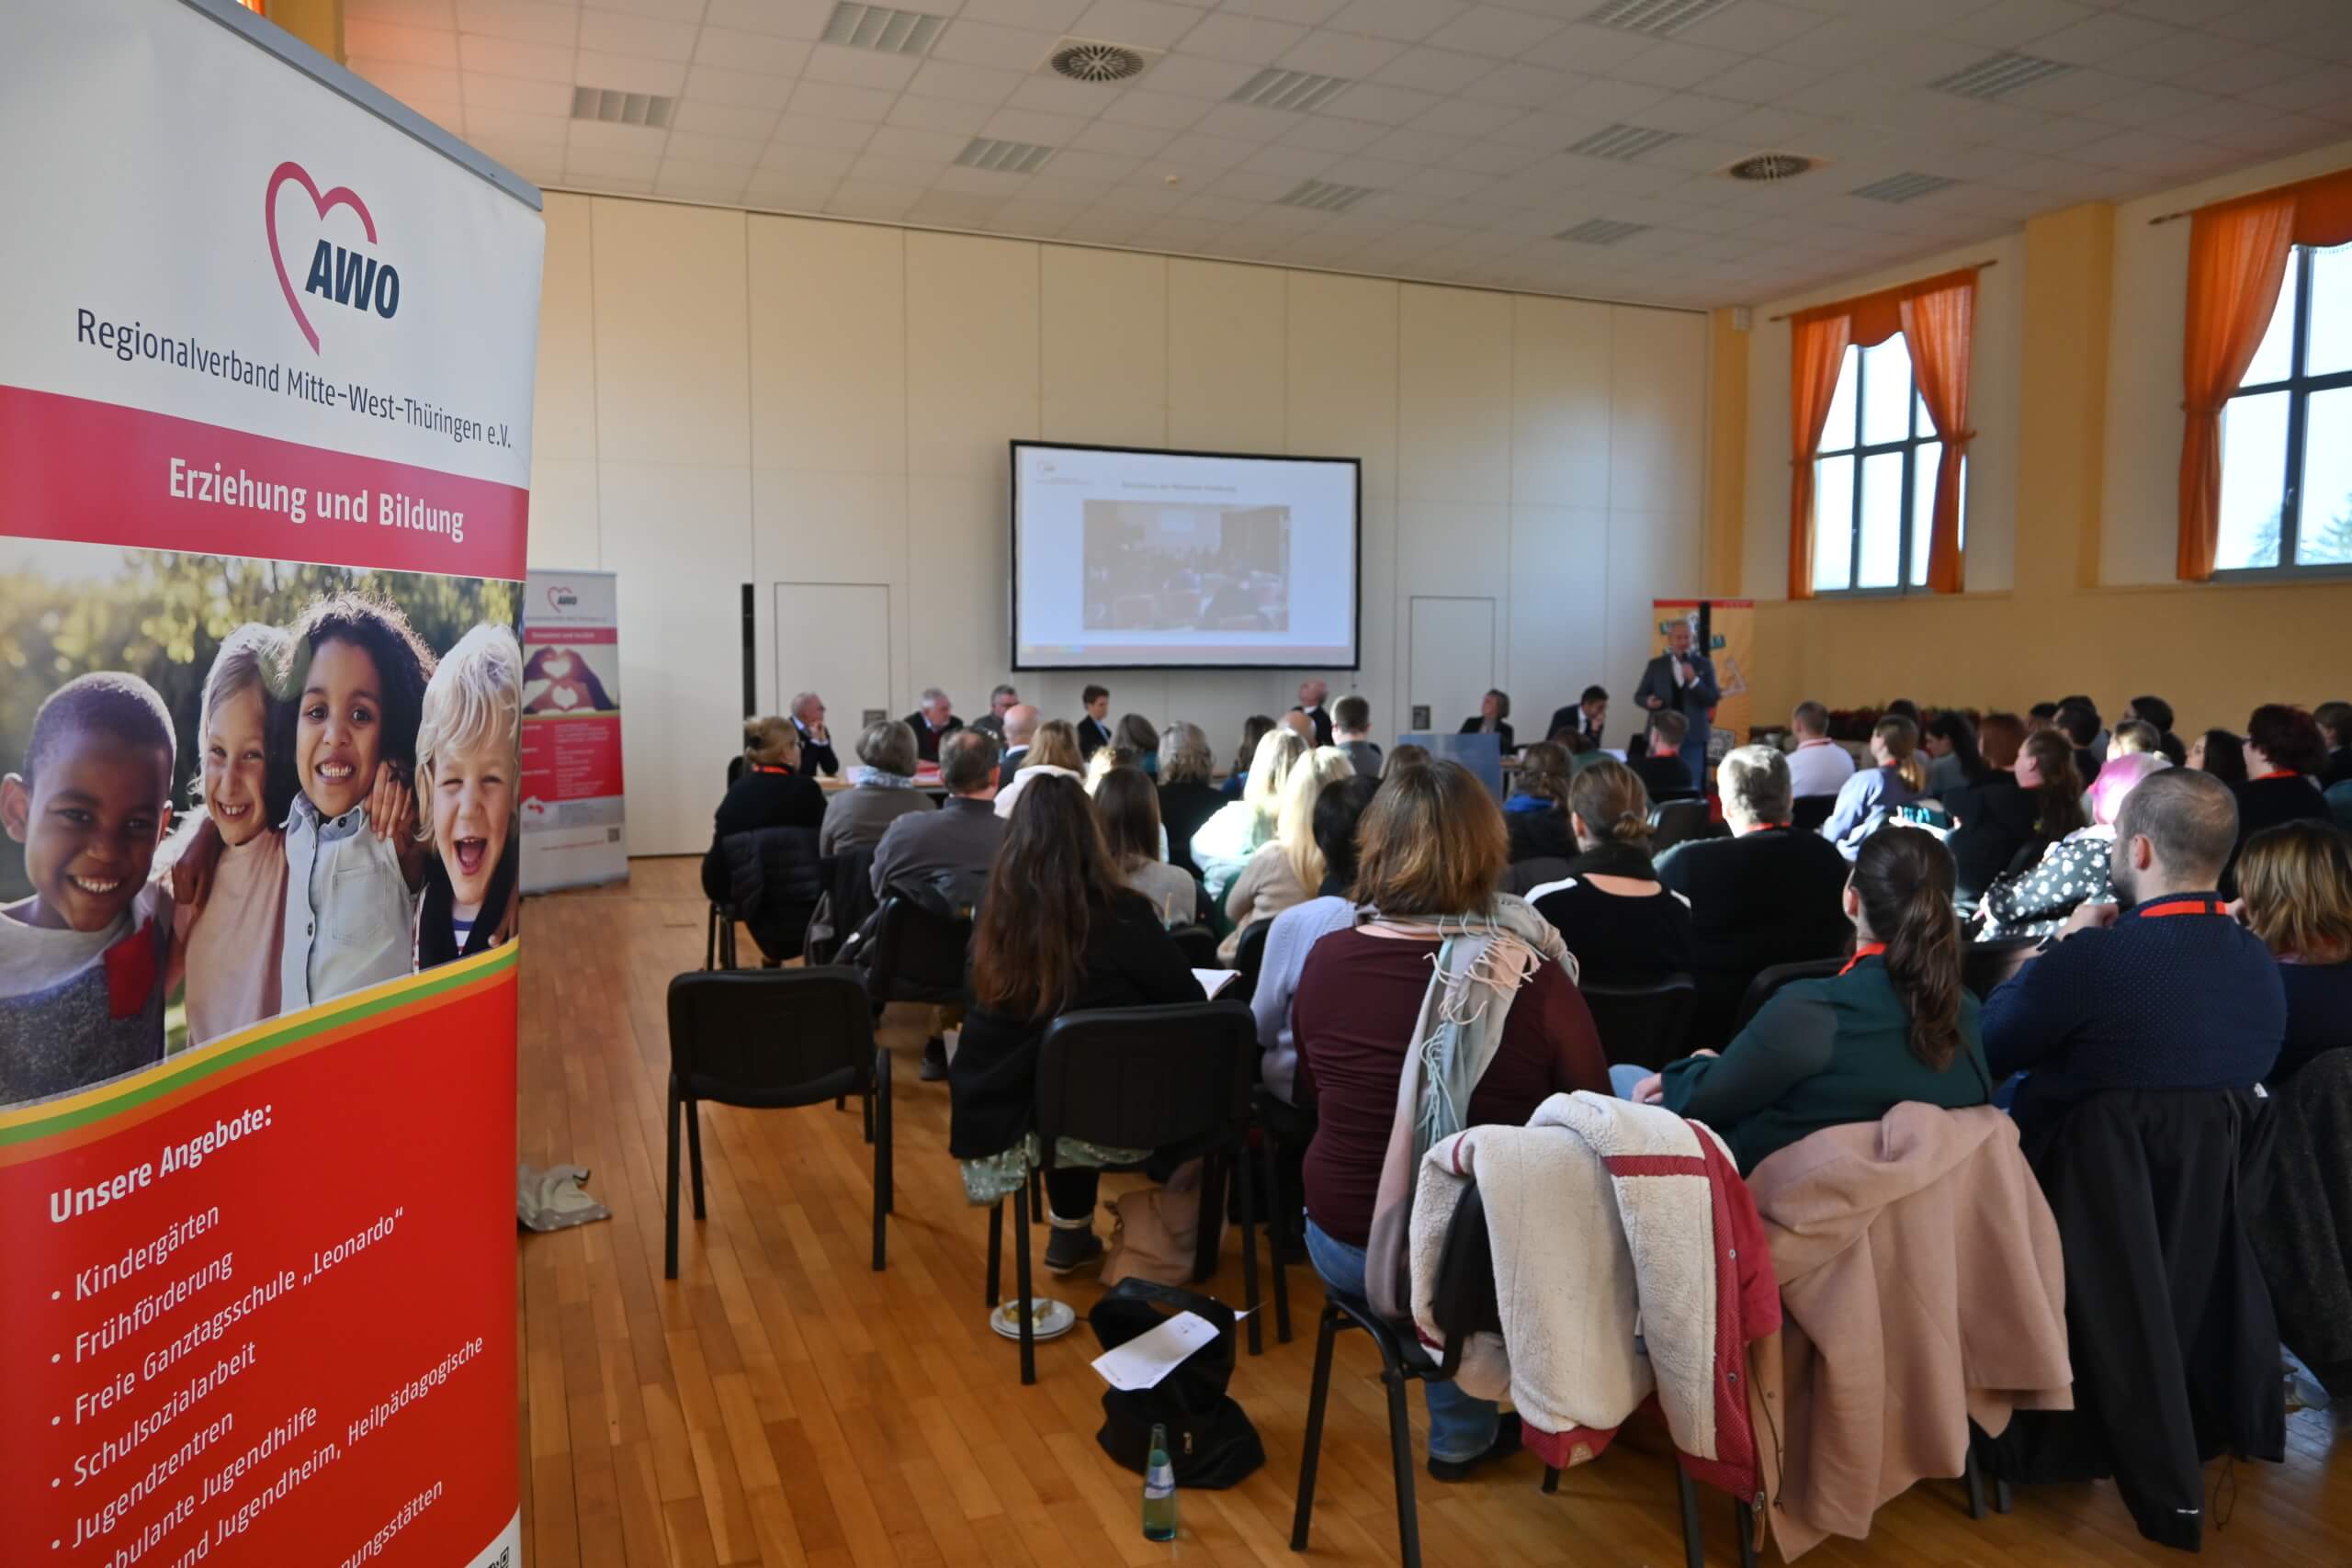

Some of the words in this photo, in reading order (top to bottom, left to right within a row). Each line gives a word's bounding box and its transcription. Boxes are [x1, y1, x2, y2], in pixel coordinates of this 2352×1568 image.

[305, 239, 400, 319] AWO
[78, 309, 278, 392] Regionalverband
[288, 367, 481, 443] Mitte-West-Thüringen
[488, 423, 511, 448] e.V.
[171, 457, 307, 523] Erziehung
[317, 490, 368, 523] und
[379, 493, 464, 543] Bildung
[51, 1163, 152, 1223] Unsere
[160, 1105, 271, 1178] Angebote:
[76, 1207, 218, 1301] Kindergärten
[76, 1252, 232, 1362] Frühförderung
[74, 1342, 255, 1485] Schulsozialarbeit
[76, 1372, 135, 1425] Freie
[144, 1271, 295, 1381] Ganztagsschule
[73, 1413, 232, 1548] Jugendzentren
[105, 1495, 194, 1568] bulante
[201, 1408, 316, 1505] Jugendhilfe
[216, 1444, 340, 1545] Jugendheim,
[349, 1337, 482, 1446] Heilpädagogische
